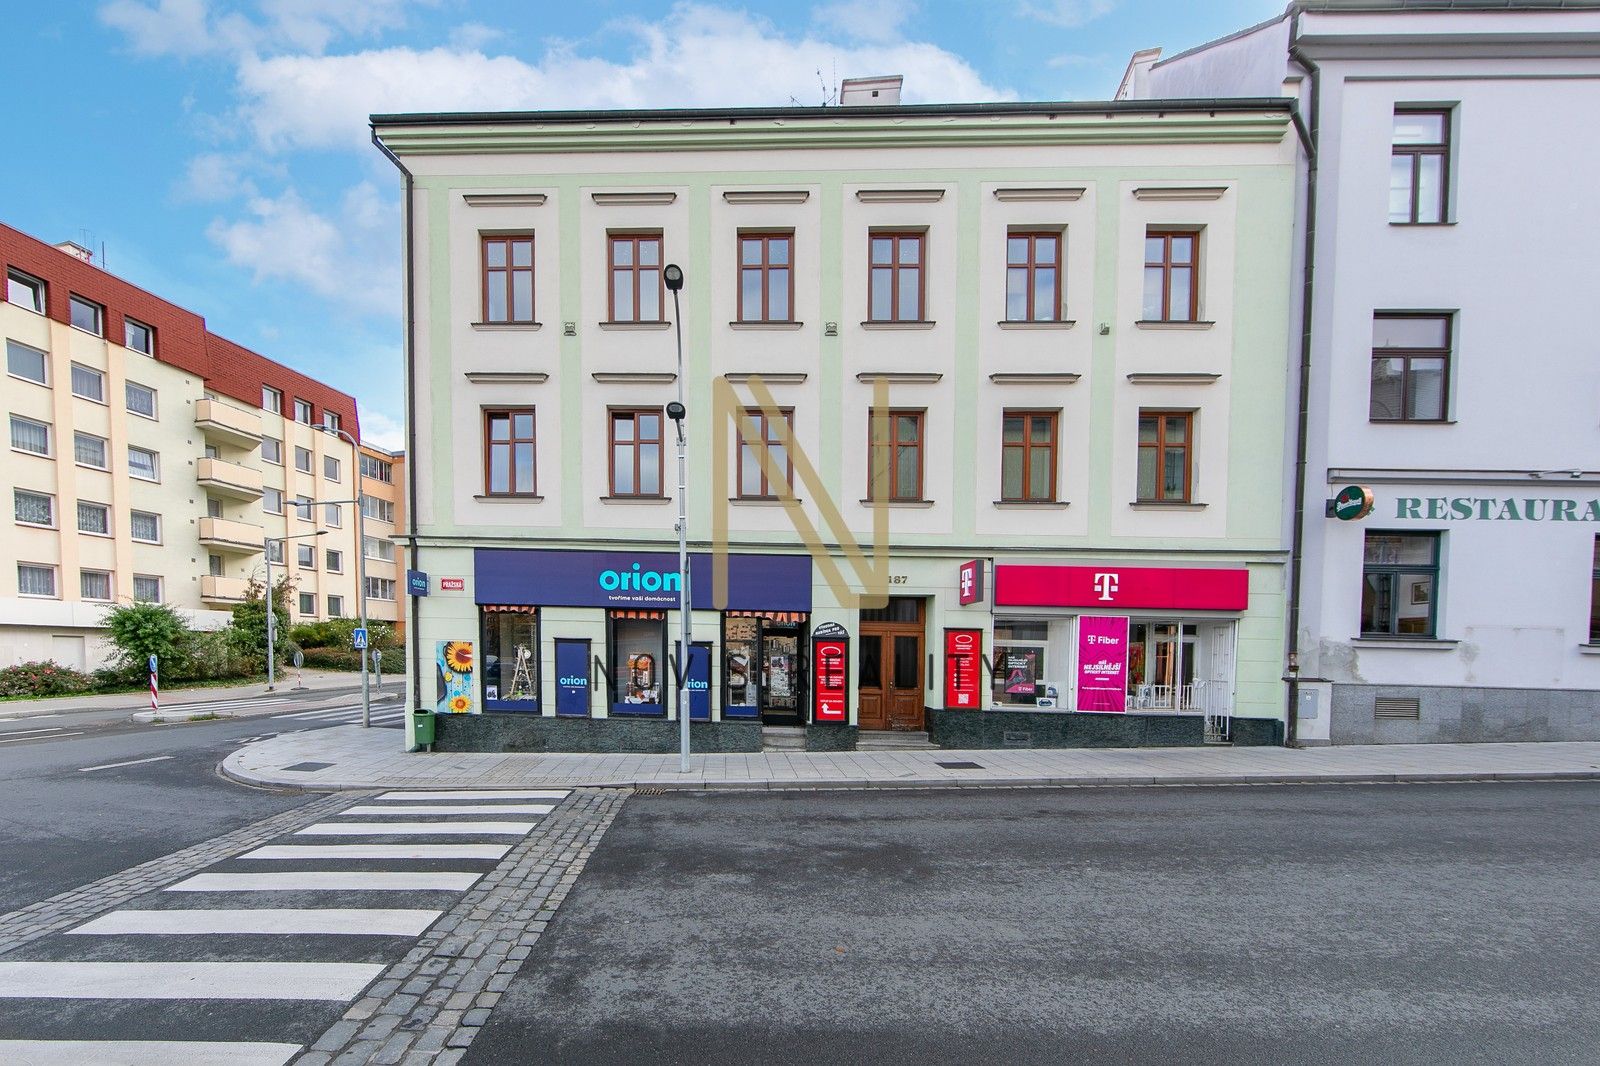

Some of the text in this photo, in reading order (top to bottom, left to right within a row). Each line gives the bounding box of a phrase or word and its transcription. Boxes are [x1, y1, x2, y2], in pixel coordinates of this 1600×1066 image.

[1394, 497, 1600, 521] RESTAURA
[600, 562, 680, 591] orion
[1097, 636, 1120, 645] Fiber
[560, 675, 587, 686] orion
[687, 678, 708, 689] rion
